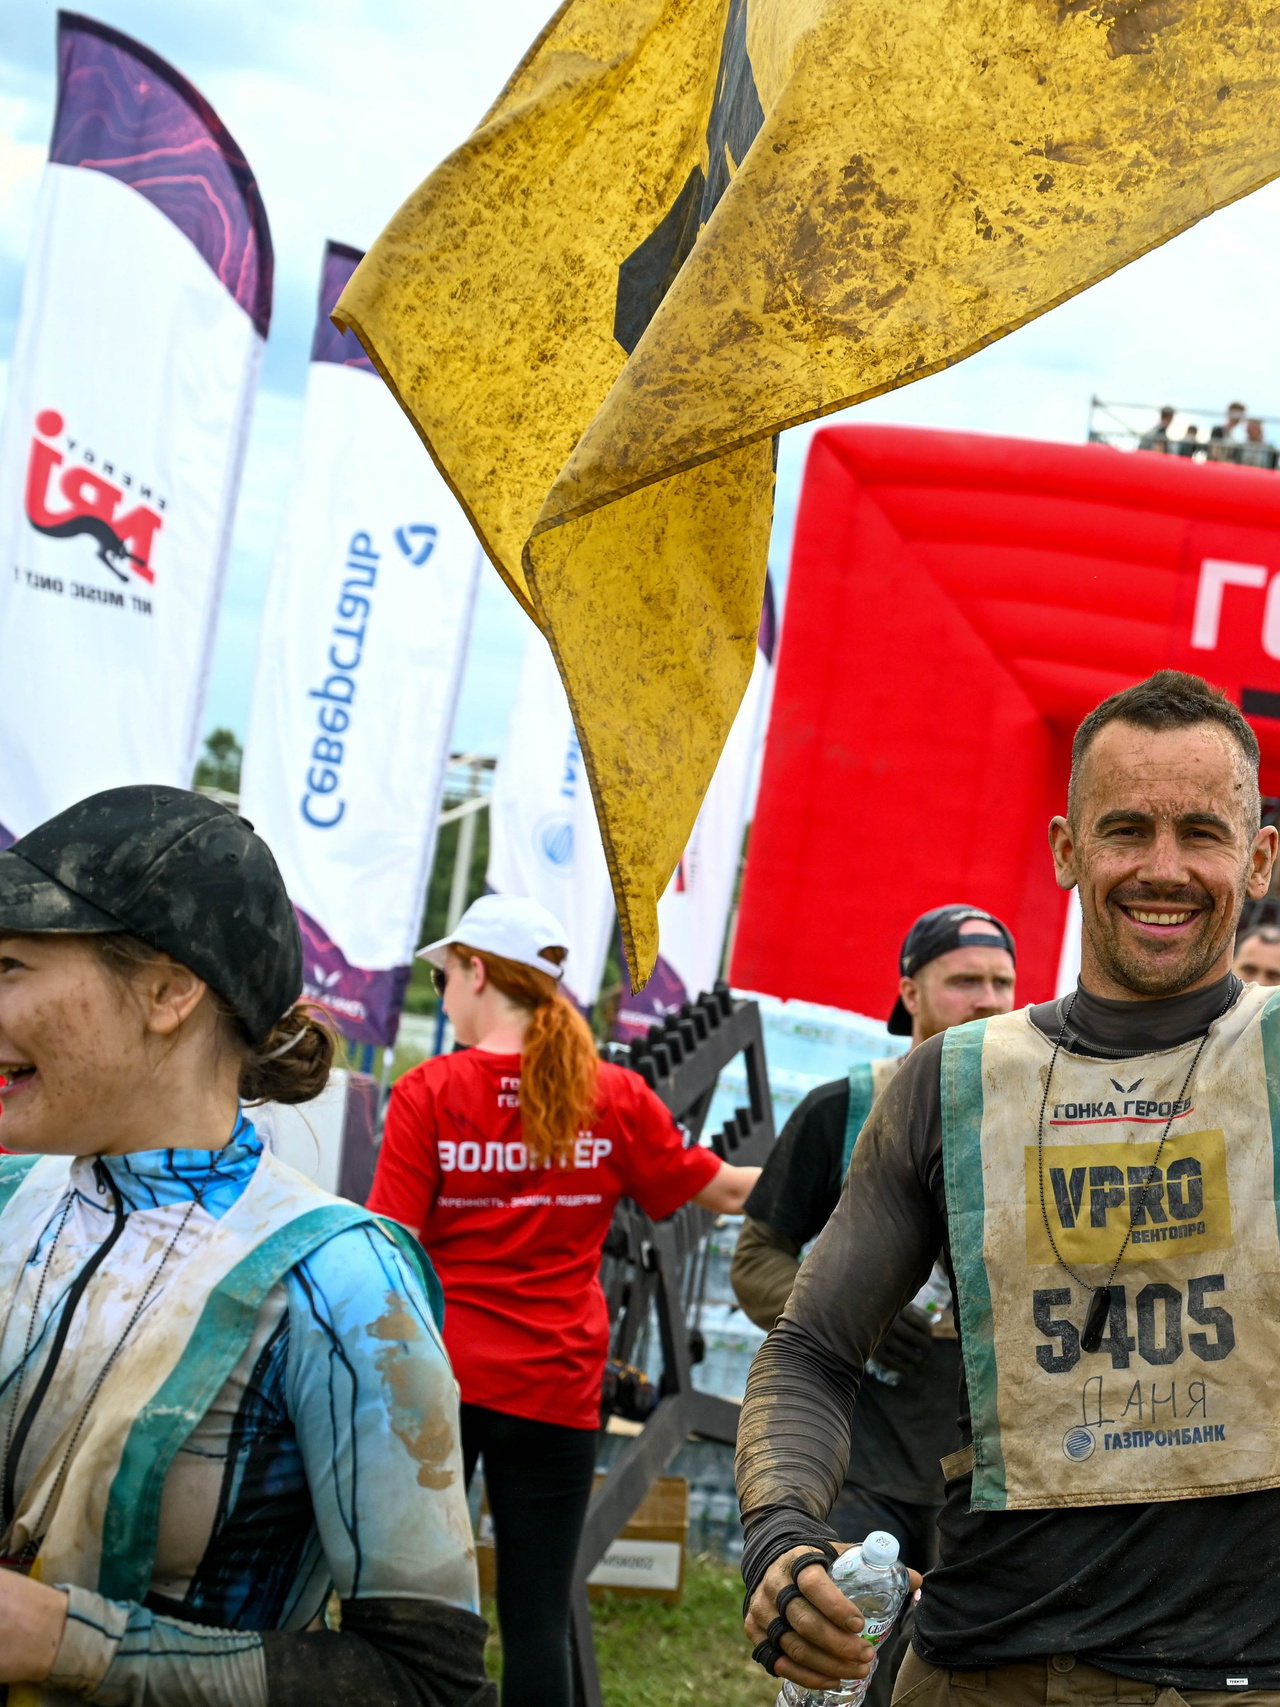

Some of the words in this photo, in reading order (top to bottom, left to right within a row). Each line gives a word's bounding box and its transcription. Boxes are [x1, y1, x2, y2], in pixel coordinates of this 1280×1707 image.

[1053, 1101, 1117, 1119] ГОНКА
[1123, 1095, 1192, 1117] ГЕРОЕВ
[437, 1131, 613, 1172] ВОЛОЁР
[1049, 1157, 1203, 1228] VPRO
[1132, 1221, 1206, 1244] ВЕНТОПРО
[1033, 1274, 1236, 1374] 5405
[1075, 1375, 1207, 1427] ДАНЯ
[1104, 1424, 1226, 1450] ГАЗПРОМБАНК
